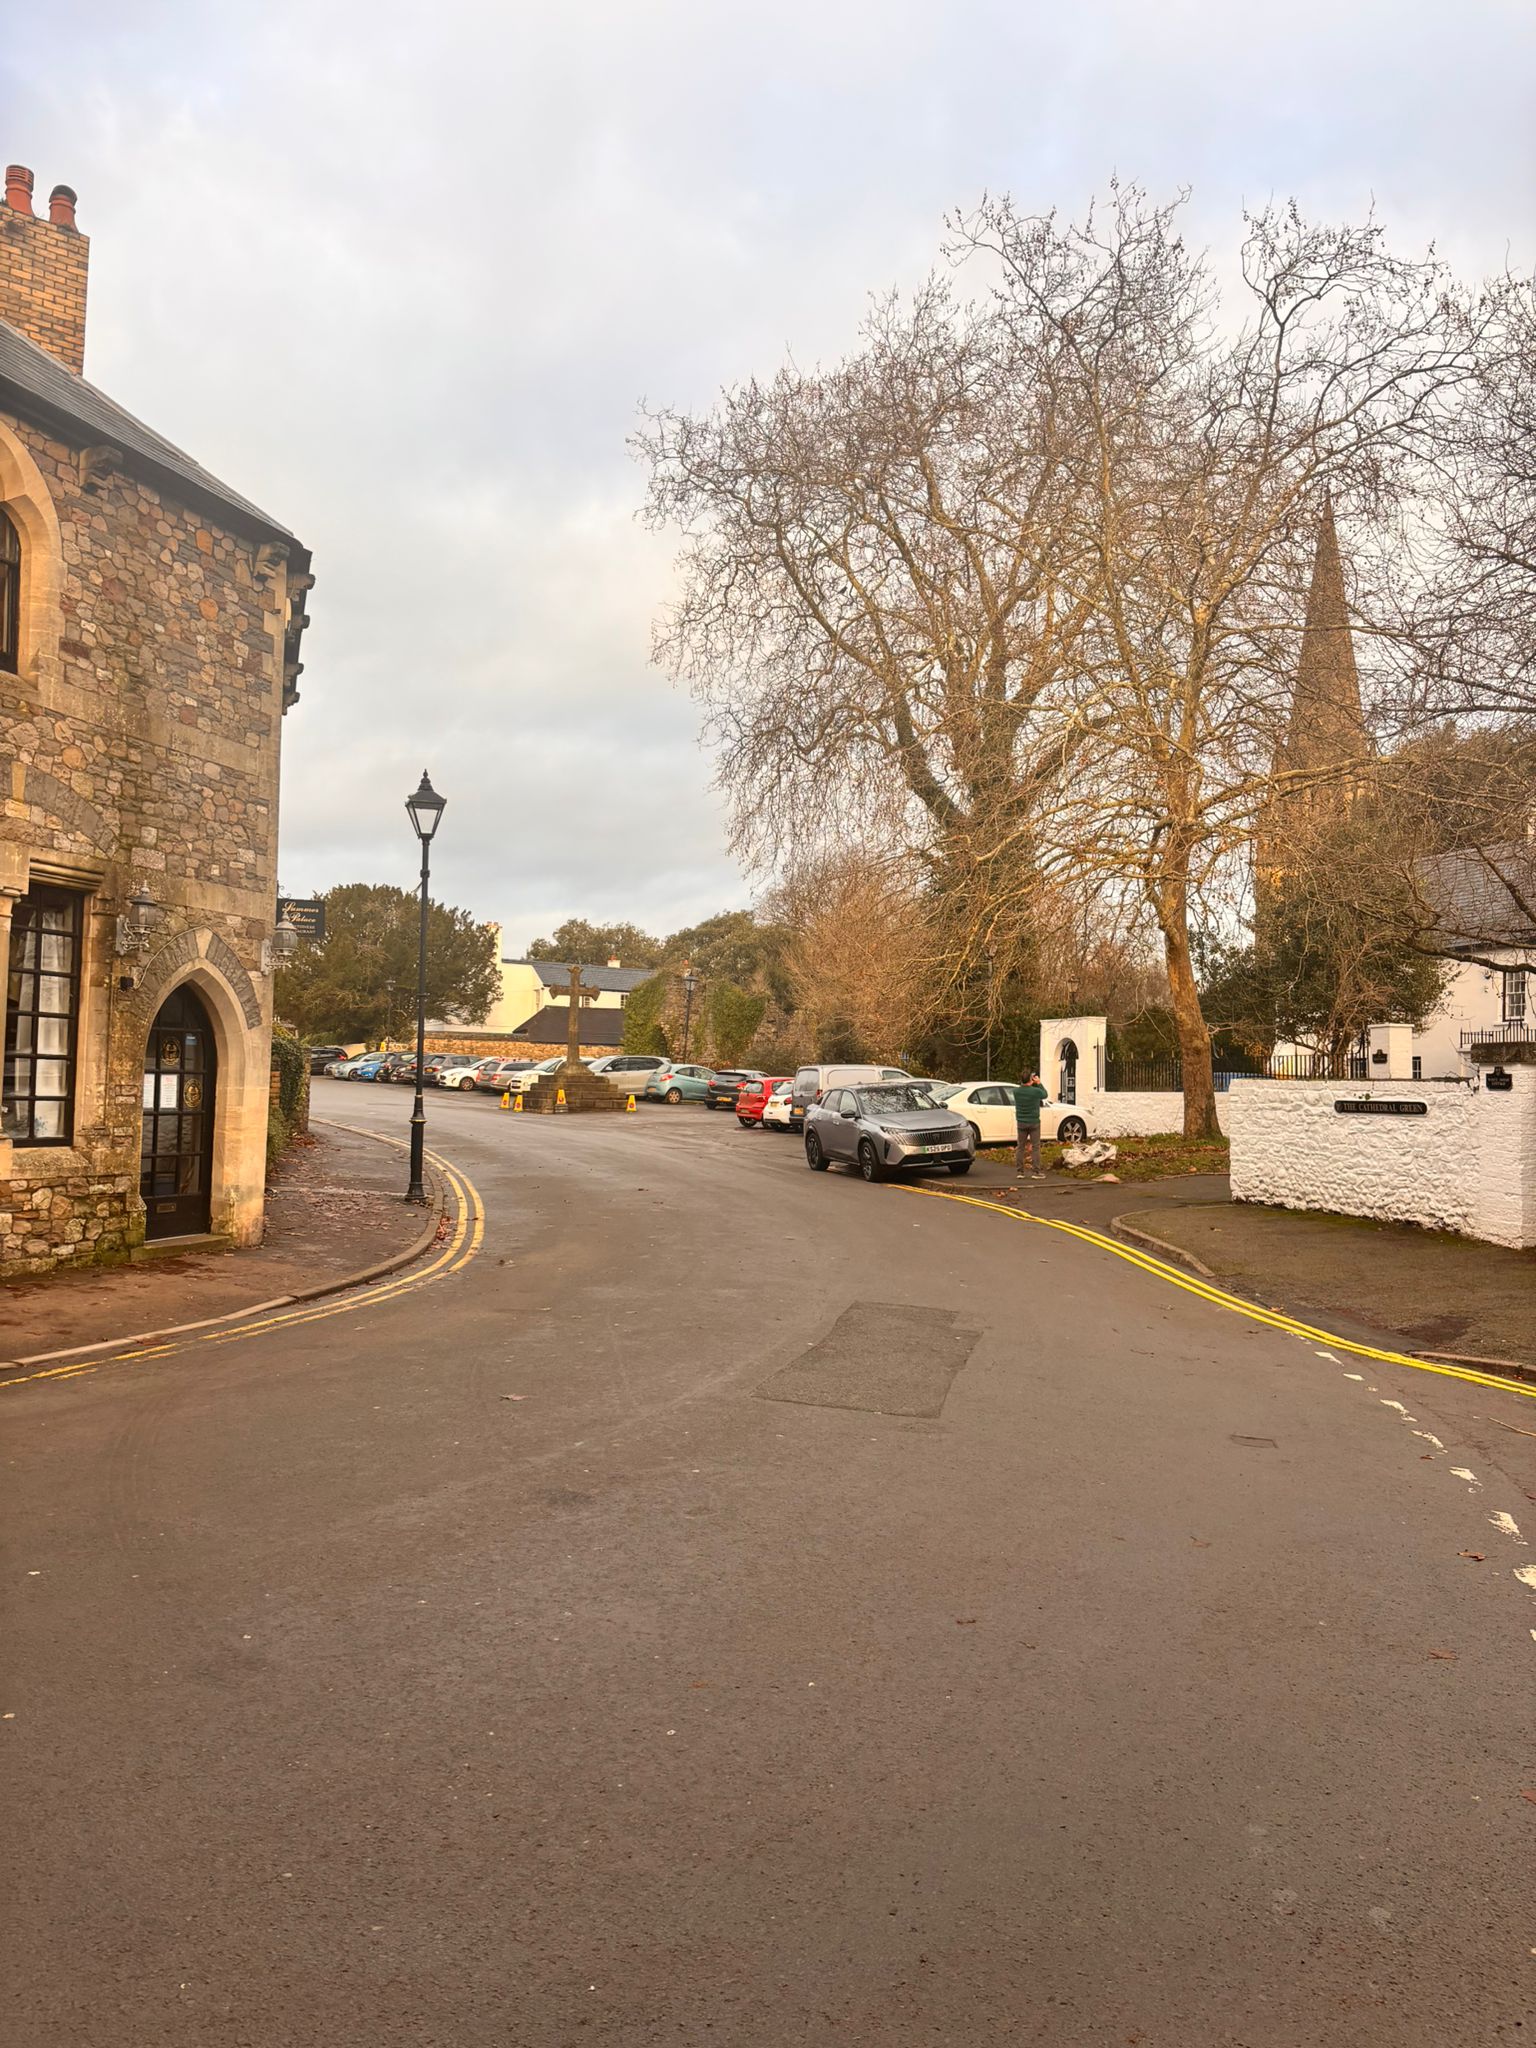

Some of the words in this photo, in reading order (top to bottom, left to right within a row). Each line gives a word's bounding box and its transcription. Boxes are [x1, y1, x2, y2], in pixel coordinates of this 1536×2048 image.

[287, 911, 317, 923] Palace
[1343, 1102, 1357, 1111] THE
[1358, 1103, 1398, 1113] CATHEDRAL
[1399, 1104, 1424, 1113] GREEN
